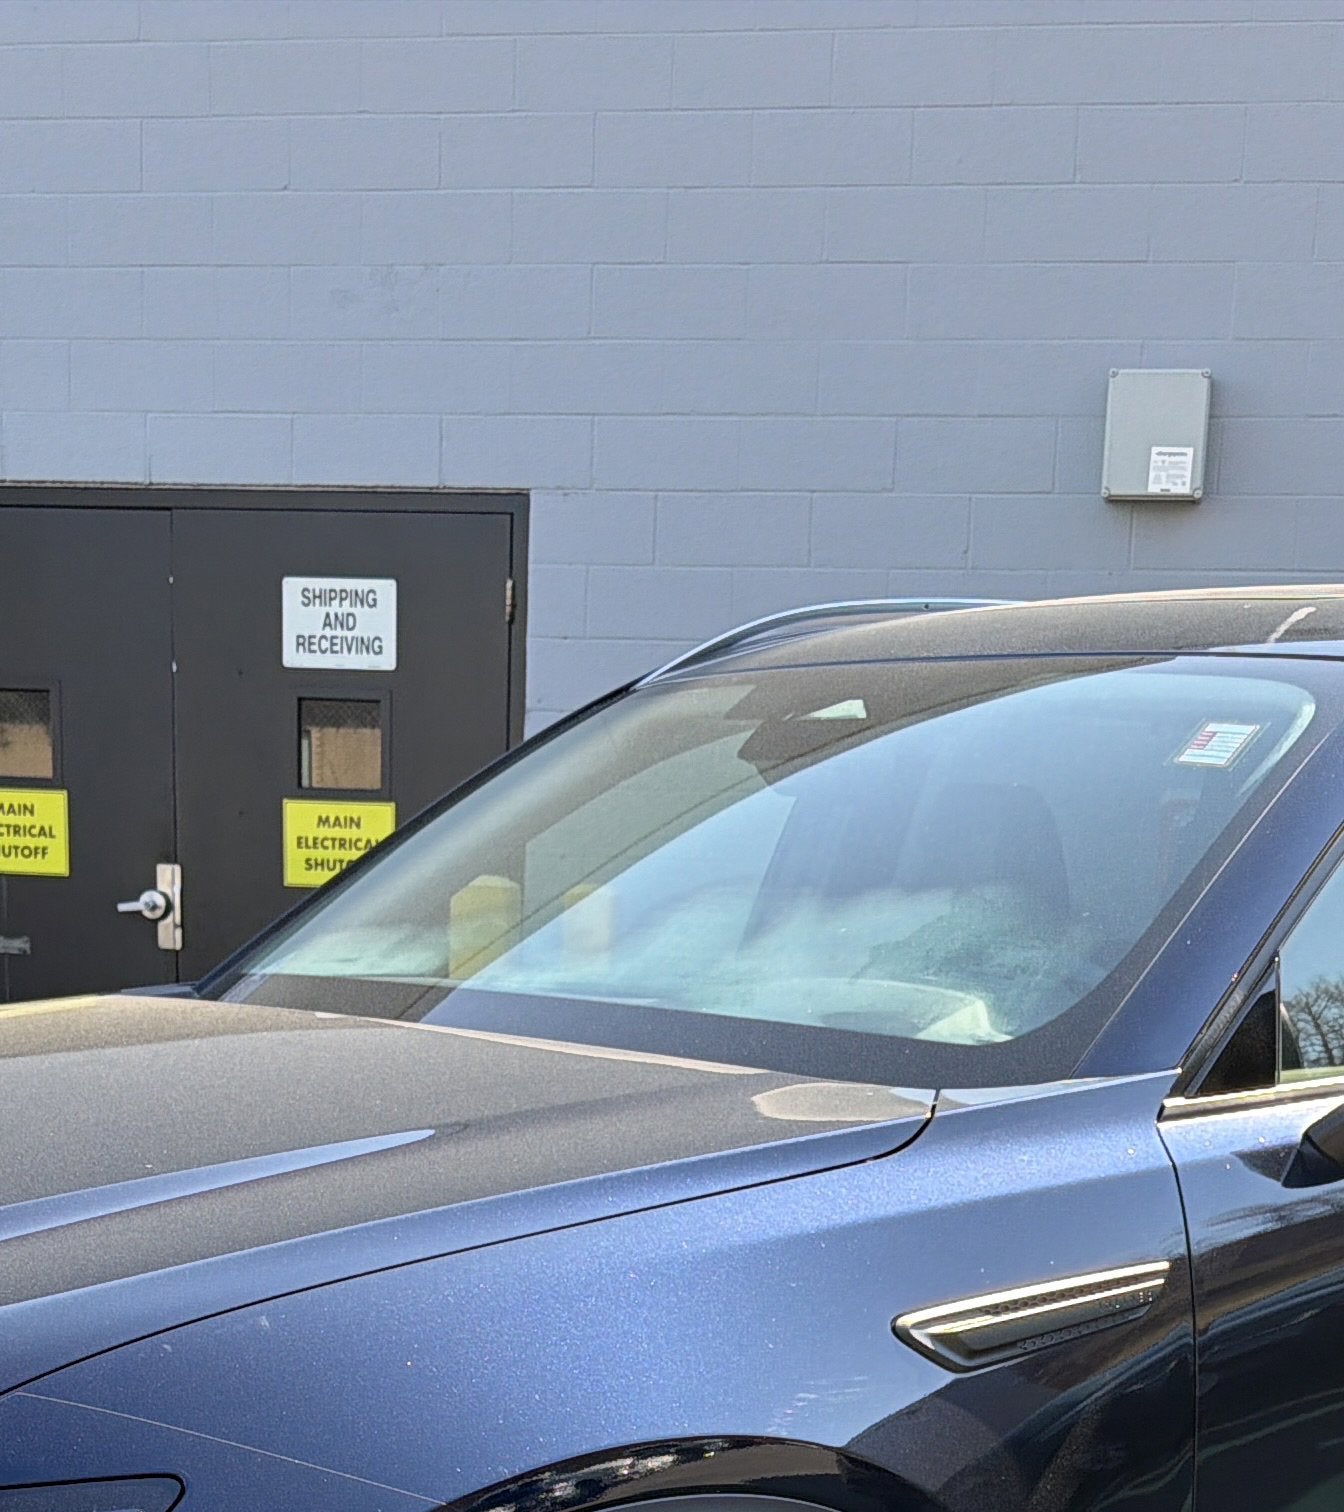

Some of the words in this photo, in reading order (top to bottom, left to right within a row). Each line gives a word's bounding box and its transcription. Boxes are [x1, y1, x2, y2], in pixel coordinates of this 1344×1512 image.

[301, 587, 377, 609] SHIPPING
[322, 611, 357, 631] AND
[296, 635, 383, 655] RECEIVING
[316, 815, 362, 829] MAIN
[296, 836, 378, 851] ELECTRICA
[304, 857, 354, 872] SHUT
